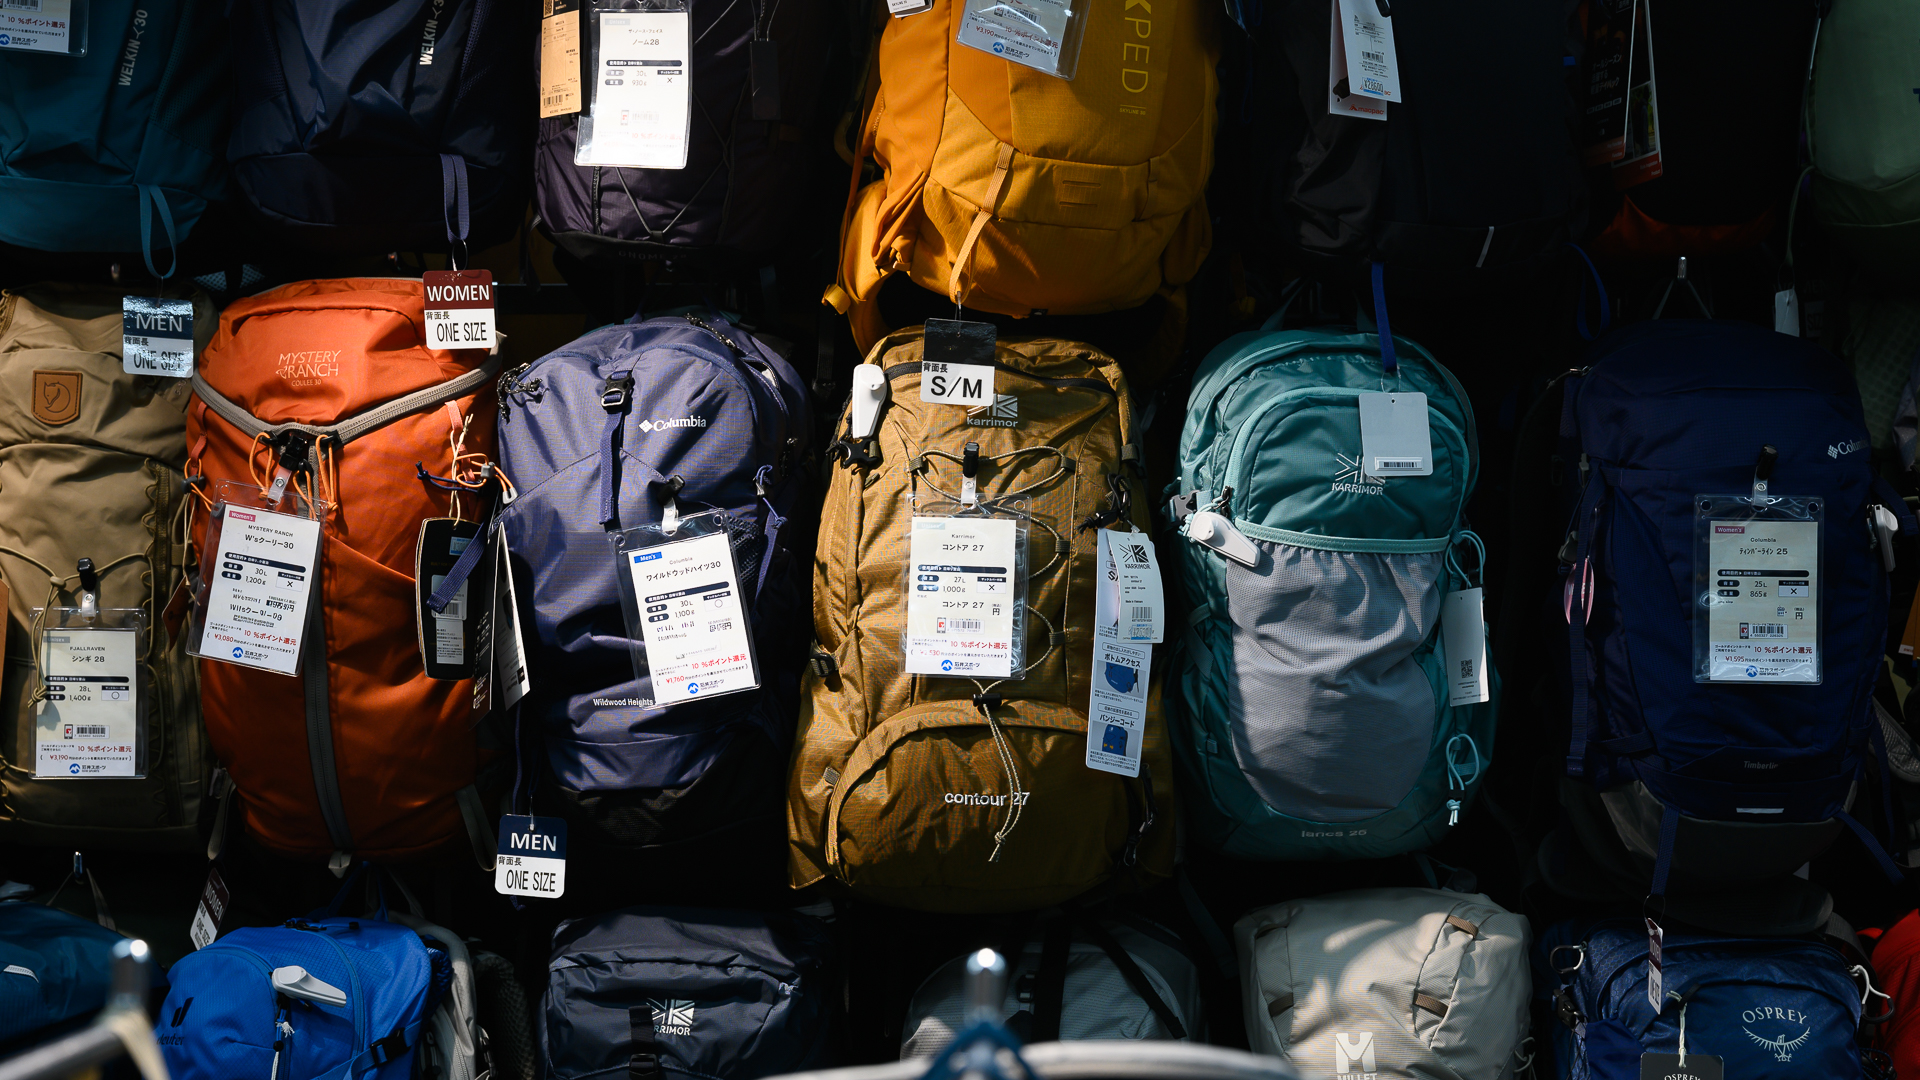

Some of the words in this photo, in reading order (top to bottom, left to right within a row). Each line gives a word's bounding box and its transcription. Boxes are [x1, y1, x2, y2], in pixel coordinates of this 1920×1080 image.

[976, 26, 994, 37] ¥3,190
[118, 39, 141, 86] WELKIN
[134, 9, 148, 27] 30
[419, 19, 438, 65] WELKIN
[1358, 106, 1384, 114] macpac
[427, 285, 490, 302] WOMEN
[136, 313, 183, 332] MEN
[426, 311, 450, 321] 背面長
[436, 323, 459, 342] ONE
[464, 322, 487, 342] SIZE
[124, 336, 149, 346] 背面長
[134, 353, 158, 370] ONE
[161, 353, 185, 372] SIZE
[278, 350, 341, 365] MYSTERY
[286, 364, 339, 378] RANCH
[923, 362, 948, 373] 背面長
[931, 376, 982, 398] S/M
[653, 415, 706, 431] Columbia
[967, 416, 1018, 427] karrimor
[1332, 482, 1383, 495] KARRIMOR
[231, 512, 254, 520] Women's
[248, 525, 273, 533] MYSTERY
[245, 534, 294, 549] W'sクーリー30
[669, 557, 693, 565] Columbia
[646, 561, 721, 581] ワイルドウッドハイツ30
[214, 634, 234, 642] ¥3,080
[254, 632, 296, 645] %ポイント還元
[961, 641, 1007, 649] %ポイント還元
[701, 654, 746, 668] %ポイント還元
[1105, 654, 1140, 668] ボトムアクセス
[666, 676, 684, 684] ¥1,760
[628, 698, 654, 707] Heights
[1100, 714, 1134, 727] バンジーコード
[944, 793, 1007, 806] contour
[1013, 792, 1030, 805] 27
[510, 832, 556, 851] MEN
[498, 856, 522, 867] 背面長
[506, 869, 528, 890] ONE
[532, 871, 556, 892] SIZE
[206, 881, 224, 921] WOMEN
[1742, 1006, 1807, 1024] OSPREY
[654, 1025, 690, 1036] RRIMOR
[157, 1033, 185, 1045] deuter
